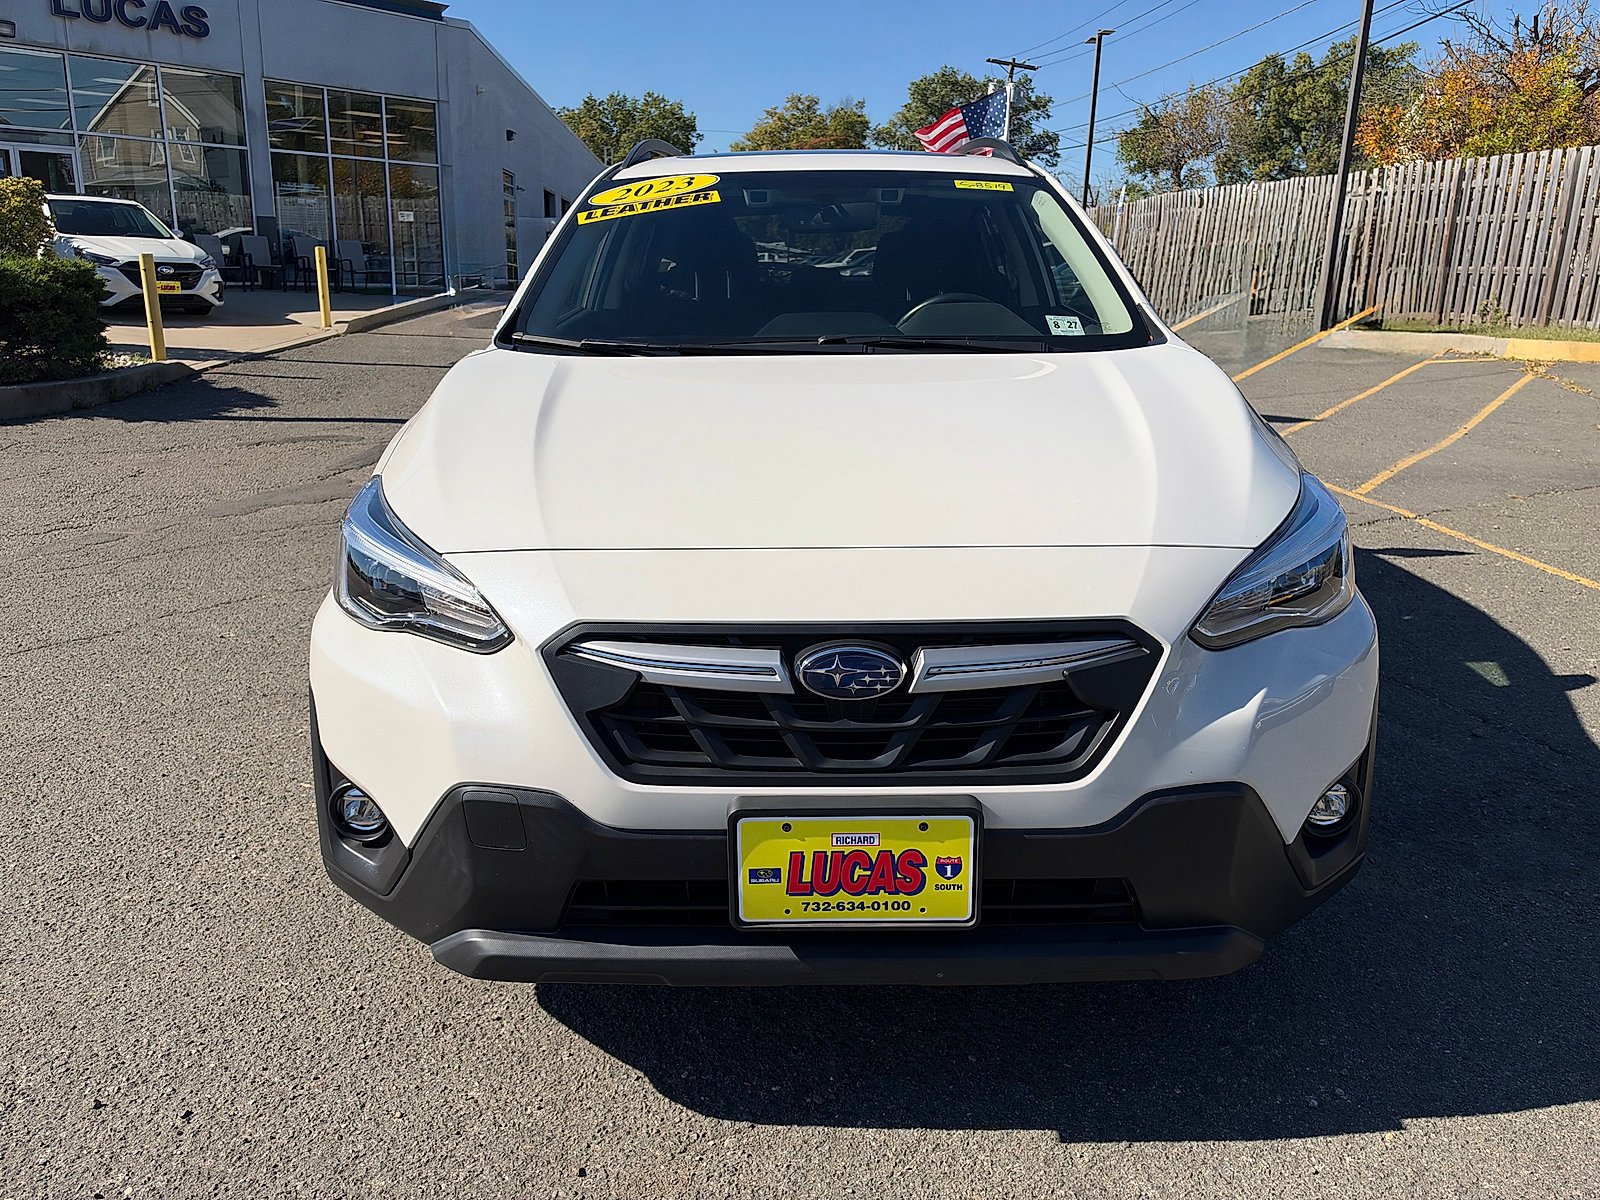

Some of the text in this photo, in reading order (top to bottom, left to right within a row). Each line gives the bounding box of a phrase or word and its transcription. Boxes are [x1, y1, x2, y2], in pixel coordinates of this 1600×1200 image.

[51, 0, 210, 39] LUCAS
[612, 177, 696, 202] 2023
[584, 192, 714, 220] LEATHER
[1053, 321, 1077, 329] 8 27
[835, 835, 876, 845] RICHARD
[786, 849, 928, 897] LUCAS
[944, 865, 953, 878] 1
[934, 883, 963, 891] SOUTH
[801, 901, 911, 912] 732-634-0100
